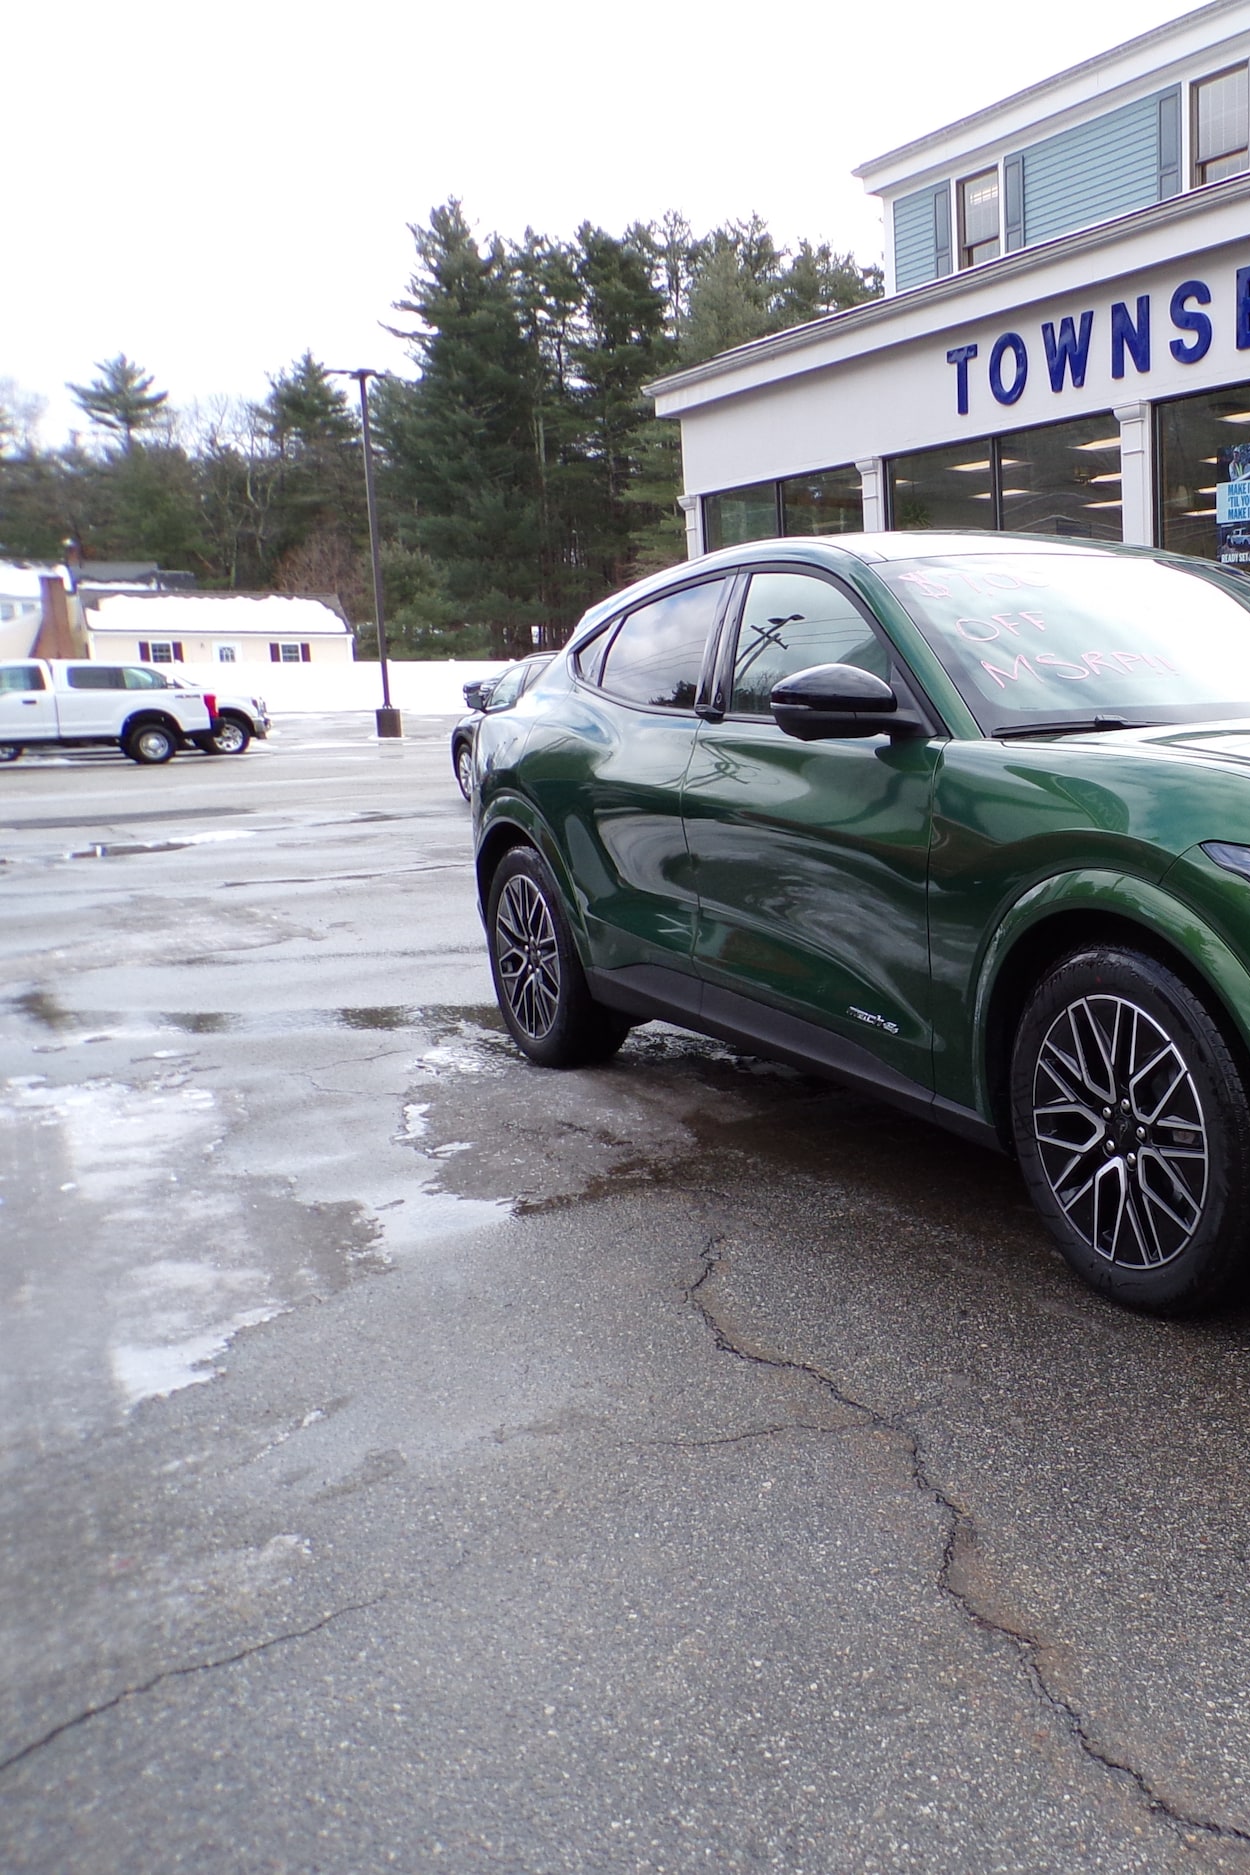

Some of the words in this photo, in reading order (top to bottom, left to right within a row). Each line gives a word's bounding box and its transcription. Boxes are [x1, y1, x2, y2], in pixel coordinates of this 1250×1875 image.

[1227, 483, 1247, 496] MAKE
[1228, 507, 1247, 520] MAKE
[1221, 552, 1239, 563] READY
[1239, 552, 1249, 562] SET
[954, 611, 1046, 642] OFF
